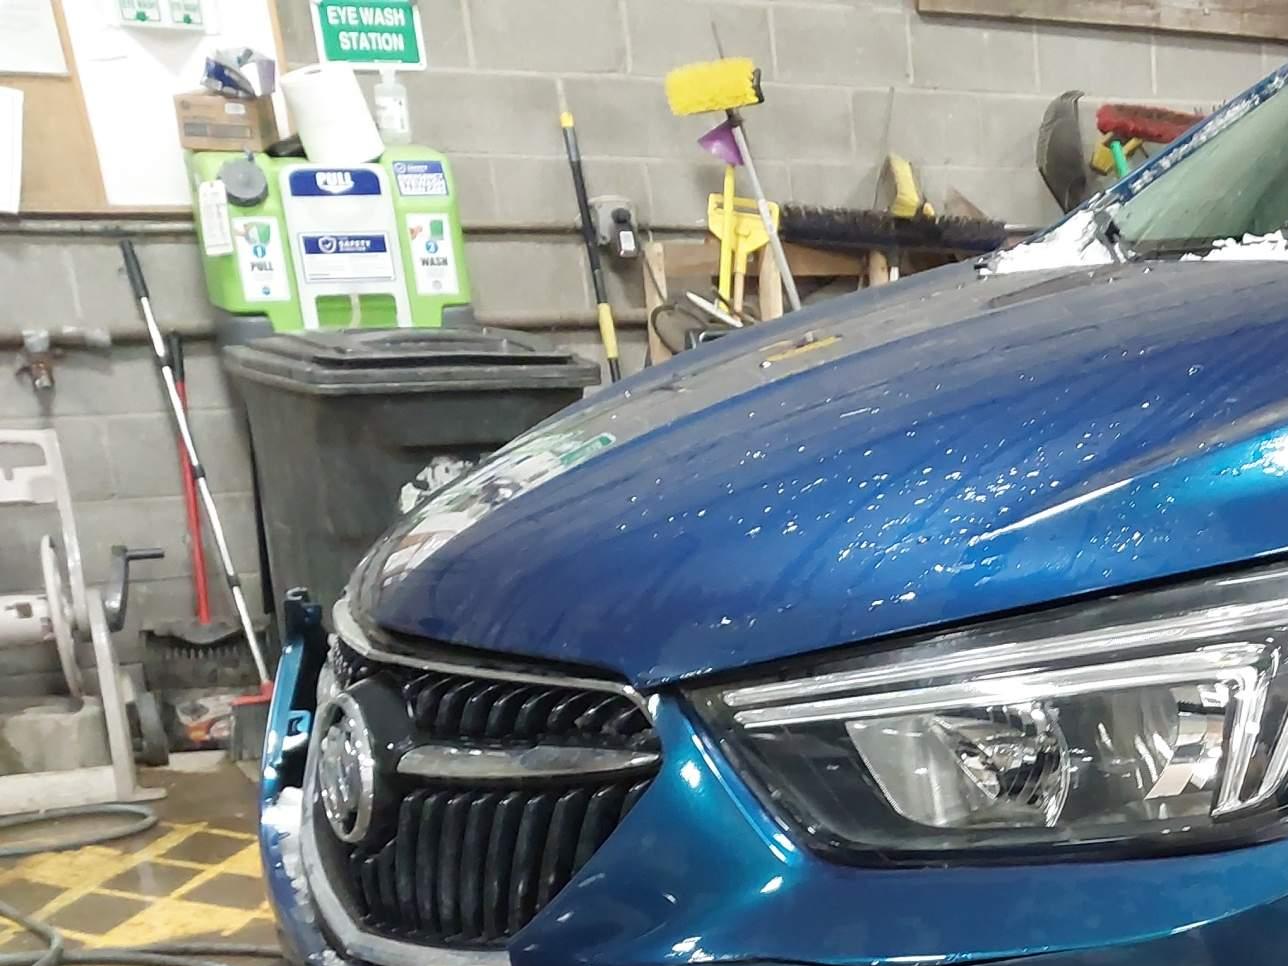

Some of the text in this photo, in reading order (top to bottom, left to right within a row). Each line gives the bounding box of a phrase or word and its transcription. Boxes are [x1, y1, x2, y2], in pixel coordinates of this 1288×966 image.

[326, 5, 406, 26] EYE WASH
[338, 31, 405, 51] STATION
[315, 171, 353, 186] PULL
[250, 261, 274, 272] PULL
[420, 256, 448, 267] WASH
